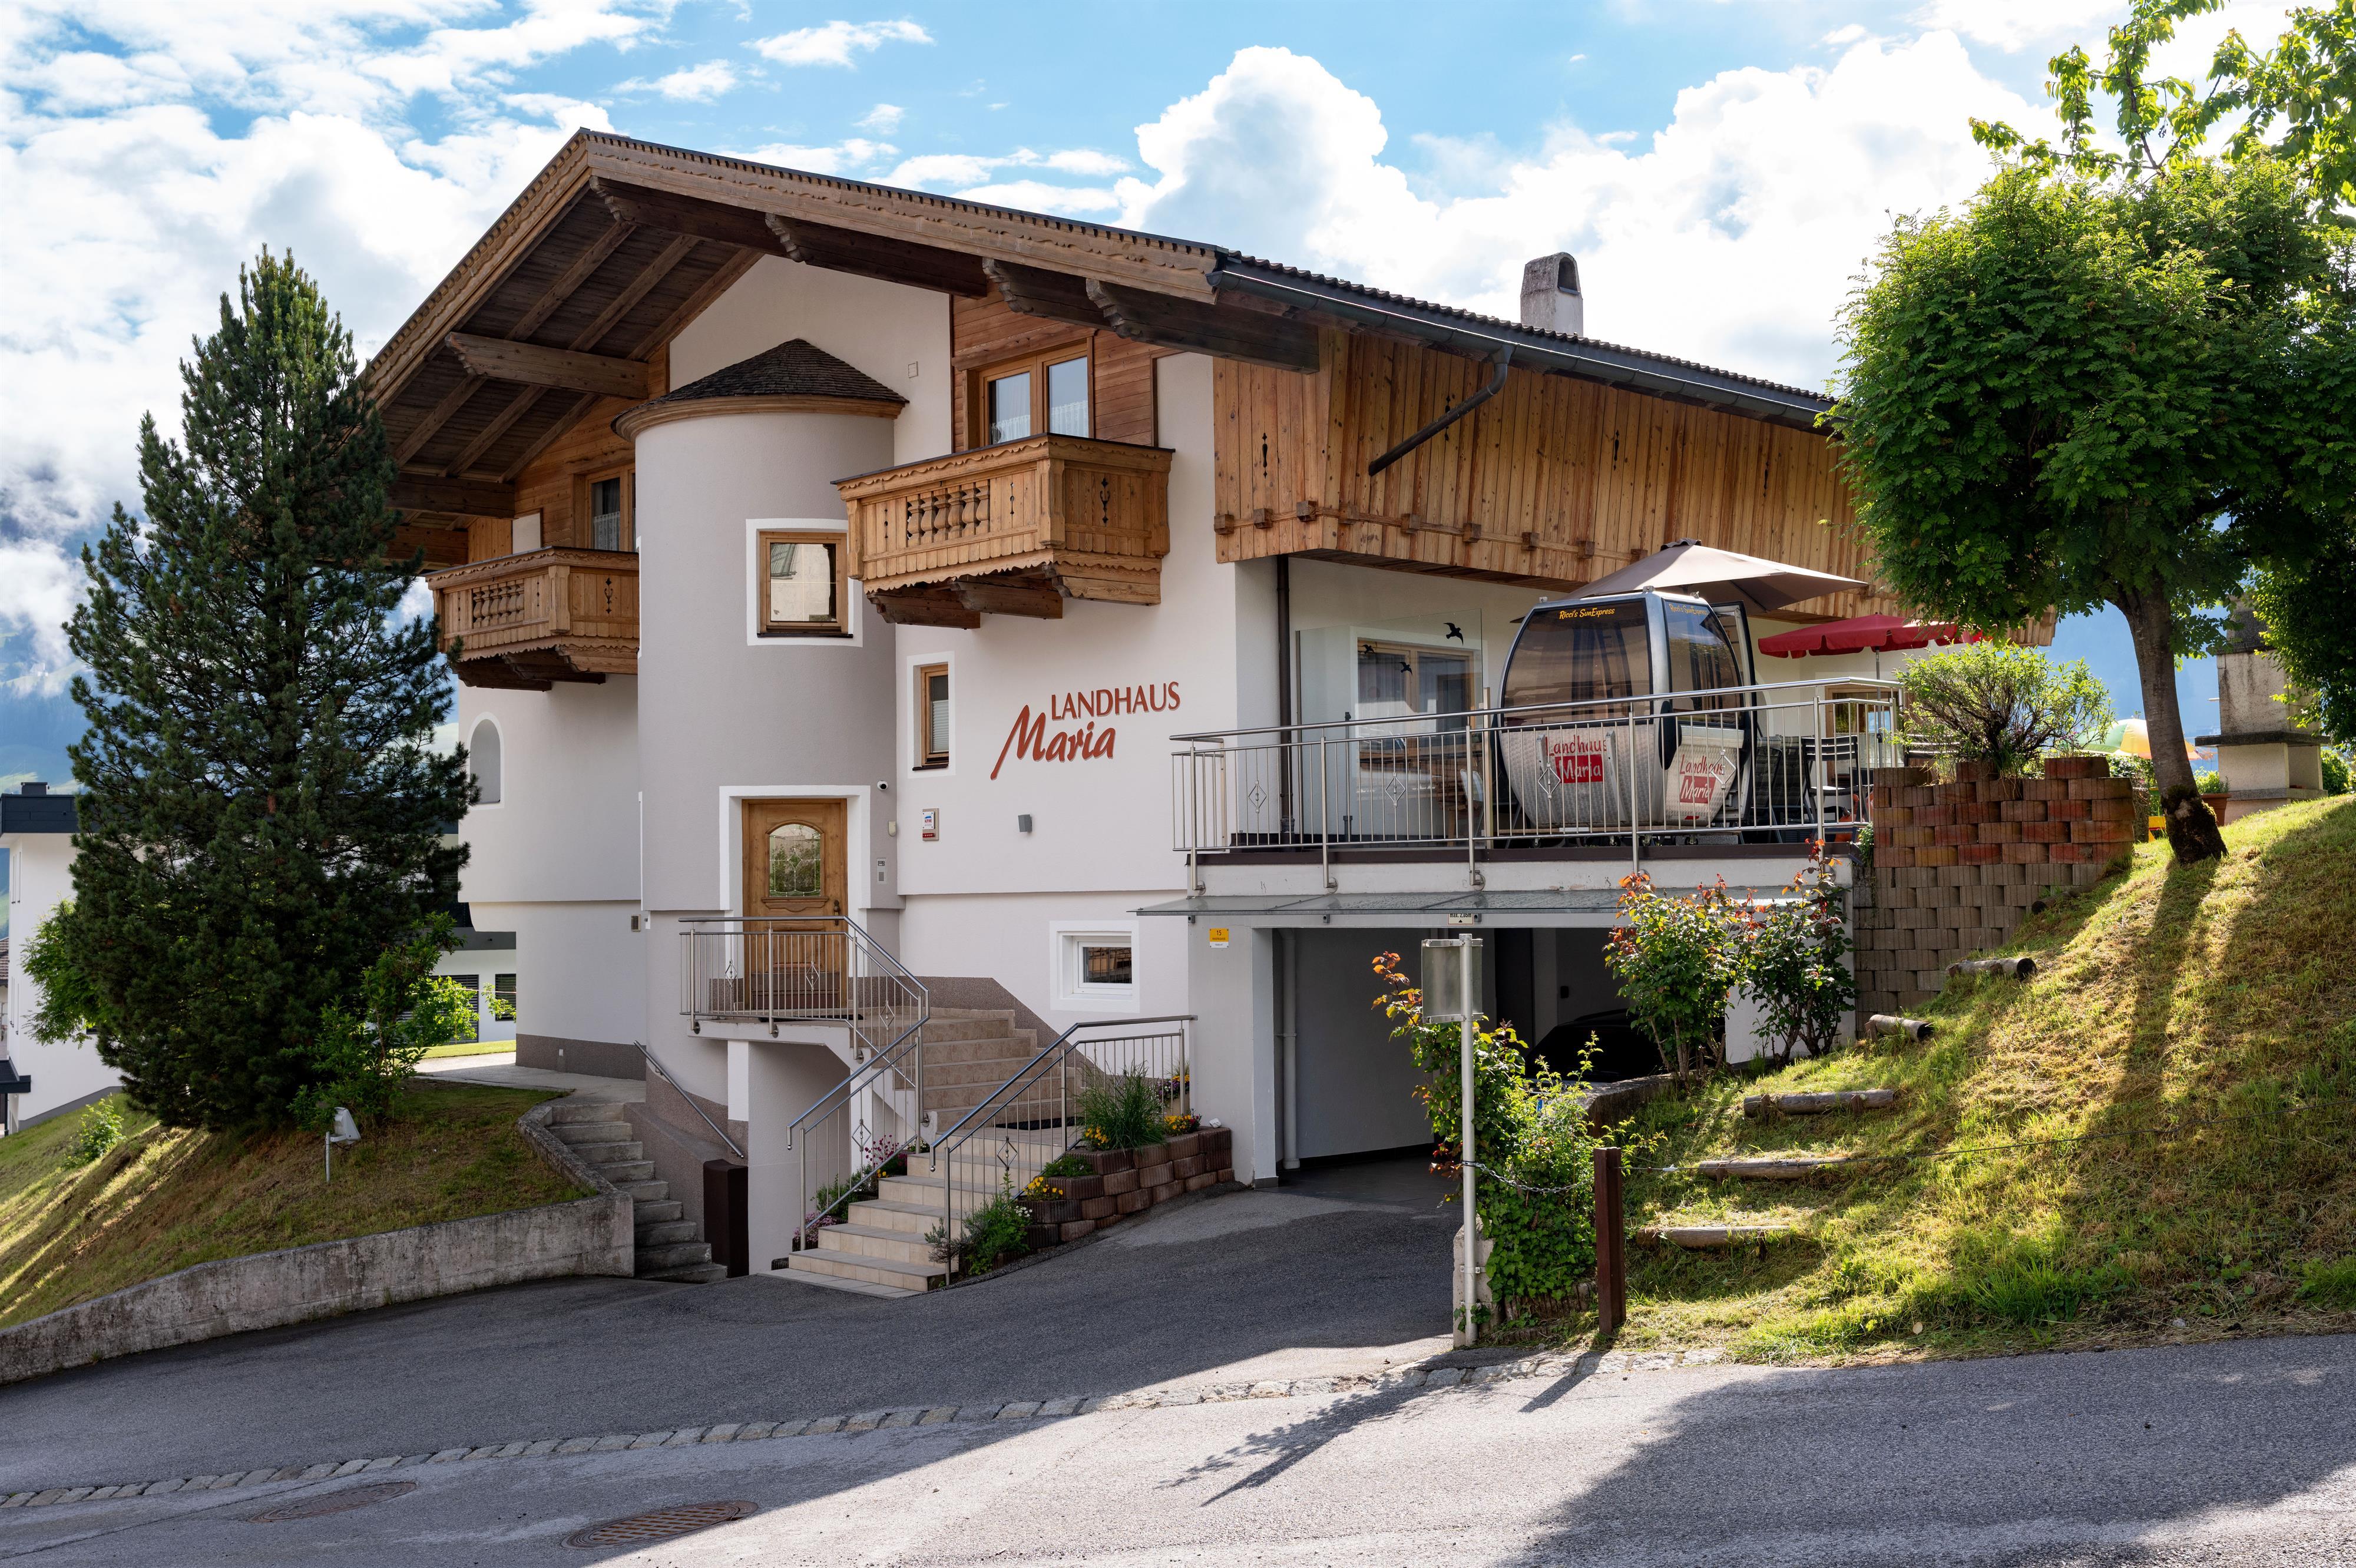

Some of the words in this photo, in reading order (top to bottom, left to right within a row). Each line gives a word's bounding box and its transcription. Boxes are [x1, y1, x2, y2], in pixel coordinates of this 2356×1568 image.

[1559, 610, 1578, 620] Ricci's
[1579, 607, 1615, 618] SunExpress
[1051, 681, 1181, 721] LANDHAUS
[990, 704, 1116, 780] Maria
[1559, 759, 1601, 780] Maria
[1680, 755, 1725, 775] Landhaus
[1681, 779, 1712, 799] Maria
